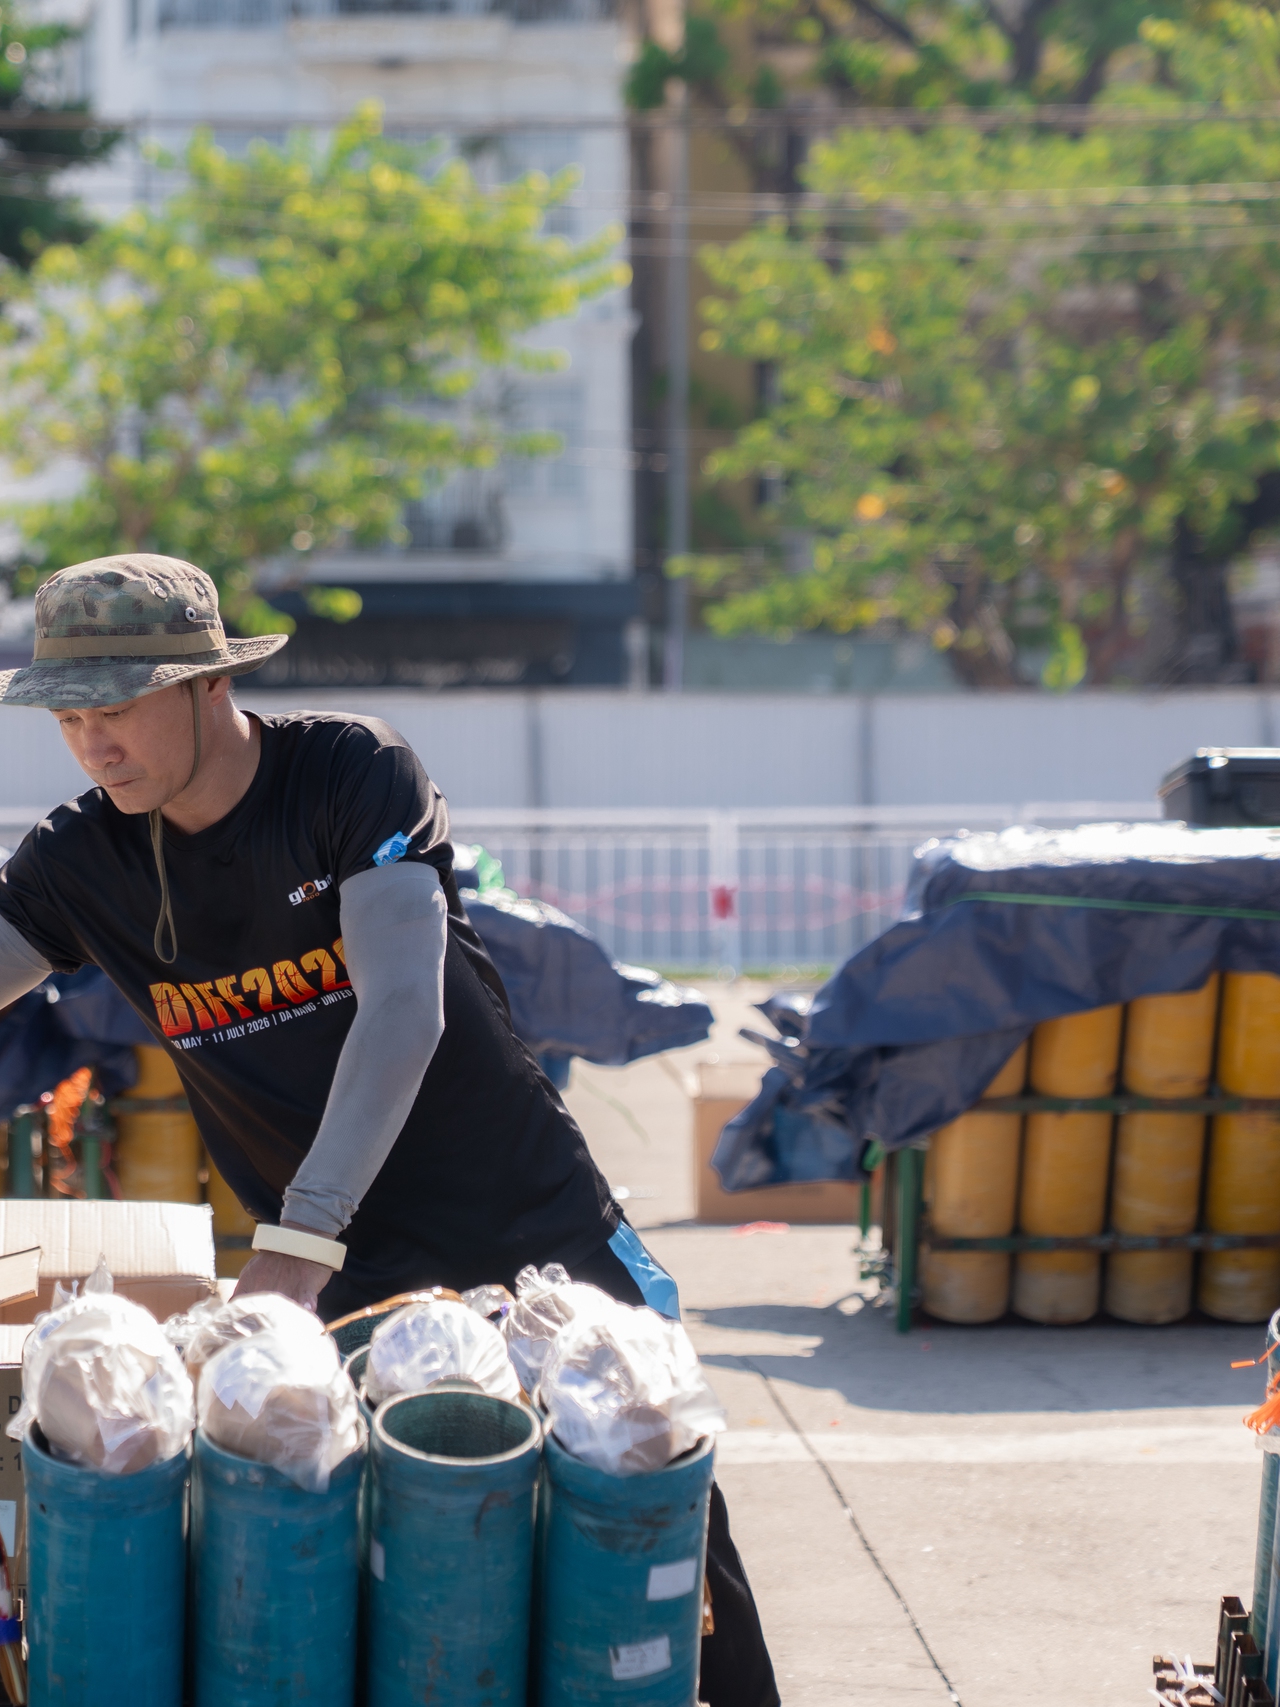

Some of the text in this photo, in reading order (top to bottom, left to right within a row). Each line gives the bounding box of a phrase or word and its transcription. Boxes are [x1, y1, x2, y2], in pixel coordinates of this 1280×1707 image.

[171, 1040, 182, 1050] 0
[181, 1035, 202, 1050] MAY
[212, 1031, 224, 1044] 11
[226, 1024, 246, 1040] JULY
[246, 1016, 270, 1034] 2026
[278, 1010, 293, 1022] DA
[292, 1002, 317, 1018] NANG
[320, 989, 353, 1006] UNITED
